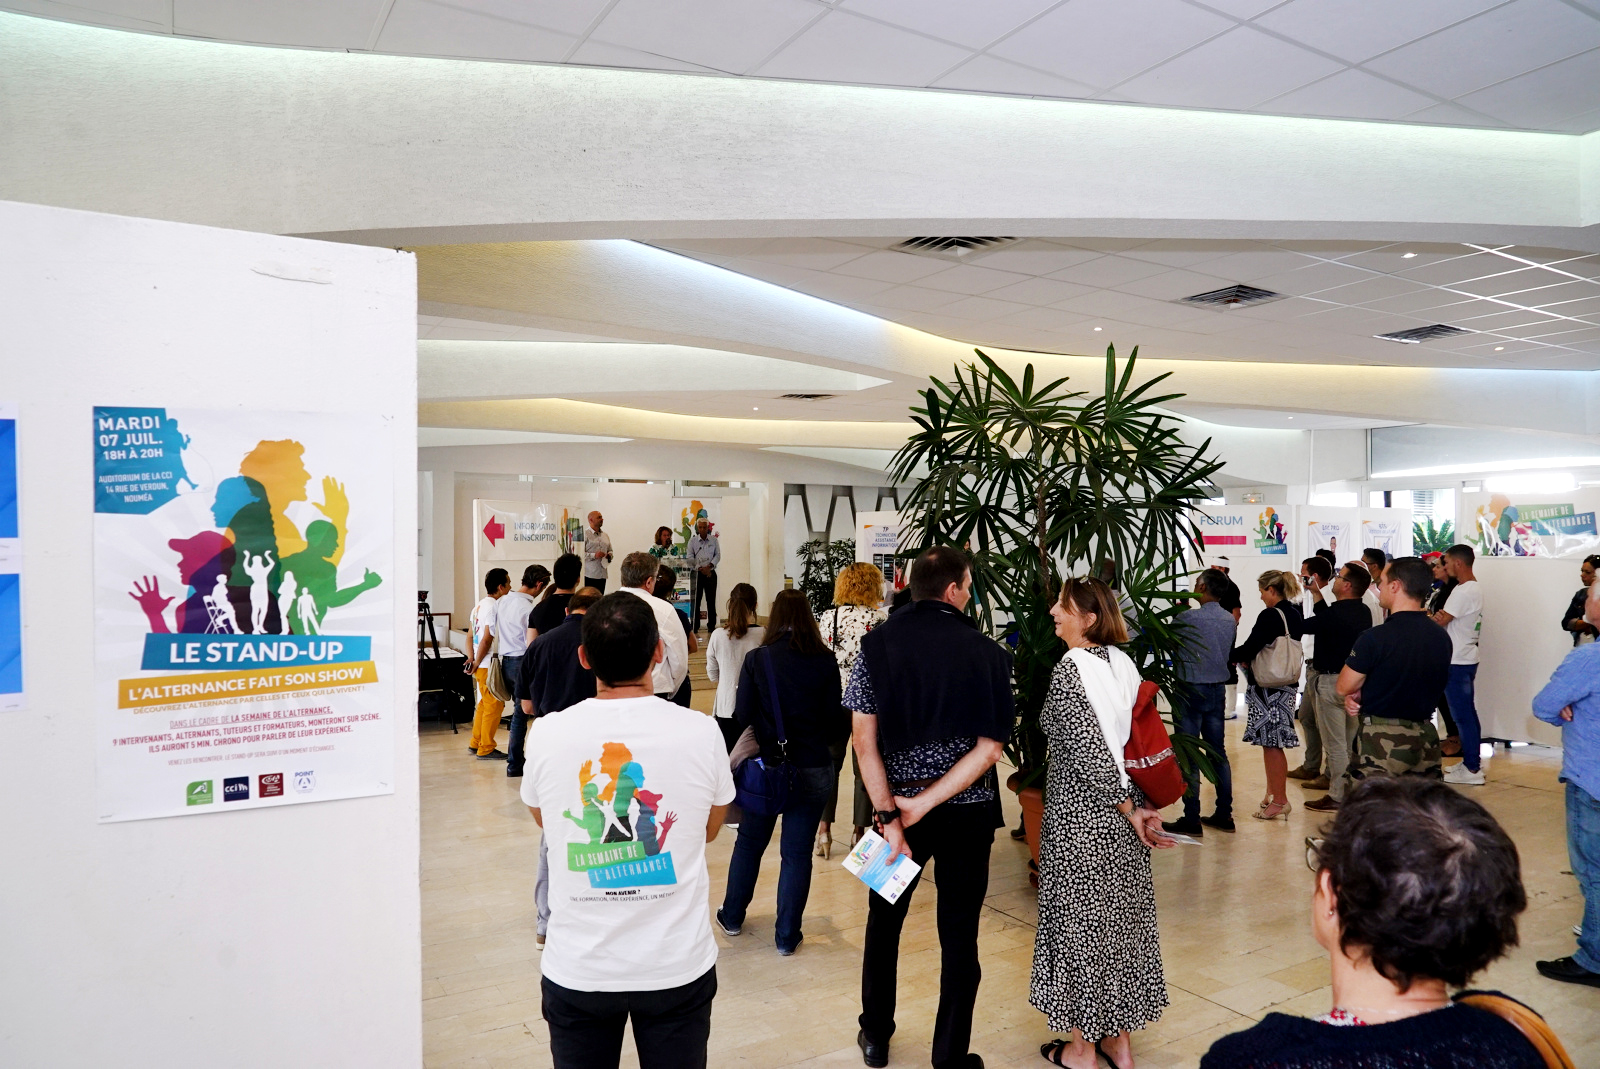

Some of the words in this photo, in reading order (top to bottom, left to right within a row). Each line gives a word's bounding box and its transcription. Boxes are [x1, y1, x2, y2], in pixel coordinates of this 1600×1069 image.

[98, 416, 160, 431] MARDI
[99, 434, 118, 447] 07
[122, 432, 163, 446] JUIL.
[103, 450, 126, 460] 18H
[129, 447, 138, 459] À
[140, 448, 163, 459] 20H
[98, 474, 140, 483] AUDITORIUM
[141, 472, 151, 481] DE
[151, 472, 160, 480] LA
[161, 471, 173, 479] CCI
[105, 485, 114, 494] 14
[115, 484, 129, 493] RUE
[130, 483, 139, 492] DE
[124, 493, 153, 503] NOUMÉA
[1561, 506, 1569, 515] DE
[1200, 515, 1243, 526] FORUM
[514, 534, 519, 542] &
[170, 642, 203, 663] LE
[206, 641, 343, 663] STAND-UP
[129, 677, 246, 701] L'ALTERNANCE
[249, 675, 282, 689] FAIT
[285, 672, 315, 686] SON
[318, 667, 363, 683] SHOW
[133, 702, 180, 715] DÉCOUVREZ
[183, 698, 238, 710] L'ALTERNANCE
[240, 696, 254, 704] PAR
[256, 694, 280, 702] CELLES
[336, 686, 361, 694] VIVENT
[170, 719, 187, 729] DANS
[189, 719, 197, 727] LE
[199, 717, 219, 726] CADRE
[221, 716, 229, 724] DE
[231, 715, 239, 723] LA
[241, 711, 271, 722] SEMAINE
[273, 710, 281, 718] DE
[112, 738, 117, 746] 9
[118, 733, 174, 746] INTERVENANTS,
[175, 728, 222, 740] ALTERNANTS,
[223, 725, 252, 735] TUTEURS
[254, 724, 261, 732] ET
[262, 720, 307, 731] FORMATEURS,
[308, 716, 345, 726] MONTERONT
[347, 715, 359, 723] SUR
[148, 744, 160, 753] ILS
[161, 741, 189, 752] AURONT
[190, 741, 196, 749] 5
[197, 739, 212, 748] MIN.
[214, 736, 241, 746] CHRONO
[242, 733, 261, 743] POUR
[262, 731, 286, 741] PARLER
[288, 730, 296, 738] DE
[297, 728, 313, 737] LEUR
[315, 725, 354, 736] EXPÉRIENCE.
[575, 854, 586, 867] LA
[587, 847, 623, 866] SEMAINE
[627, 844, 638, 859] DE
[594, 857, 668, 882] L'ALTERNANCE
